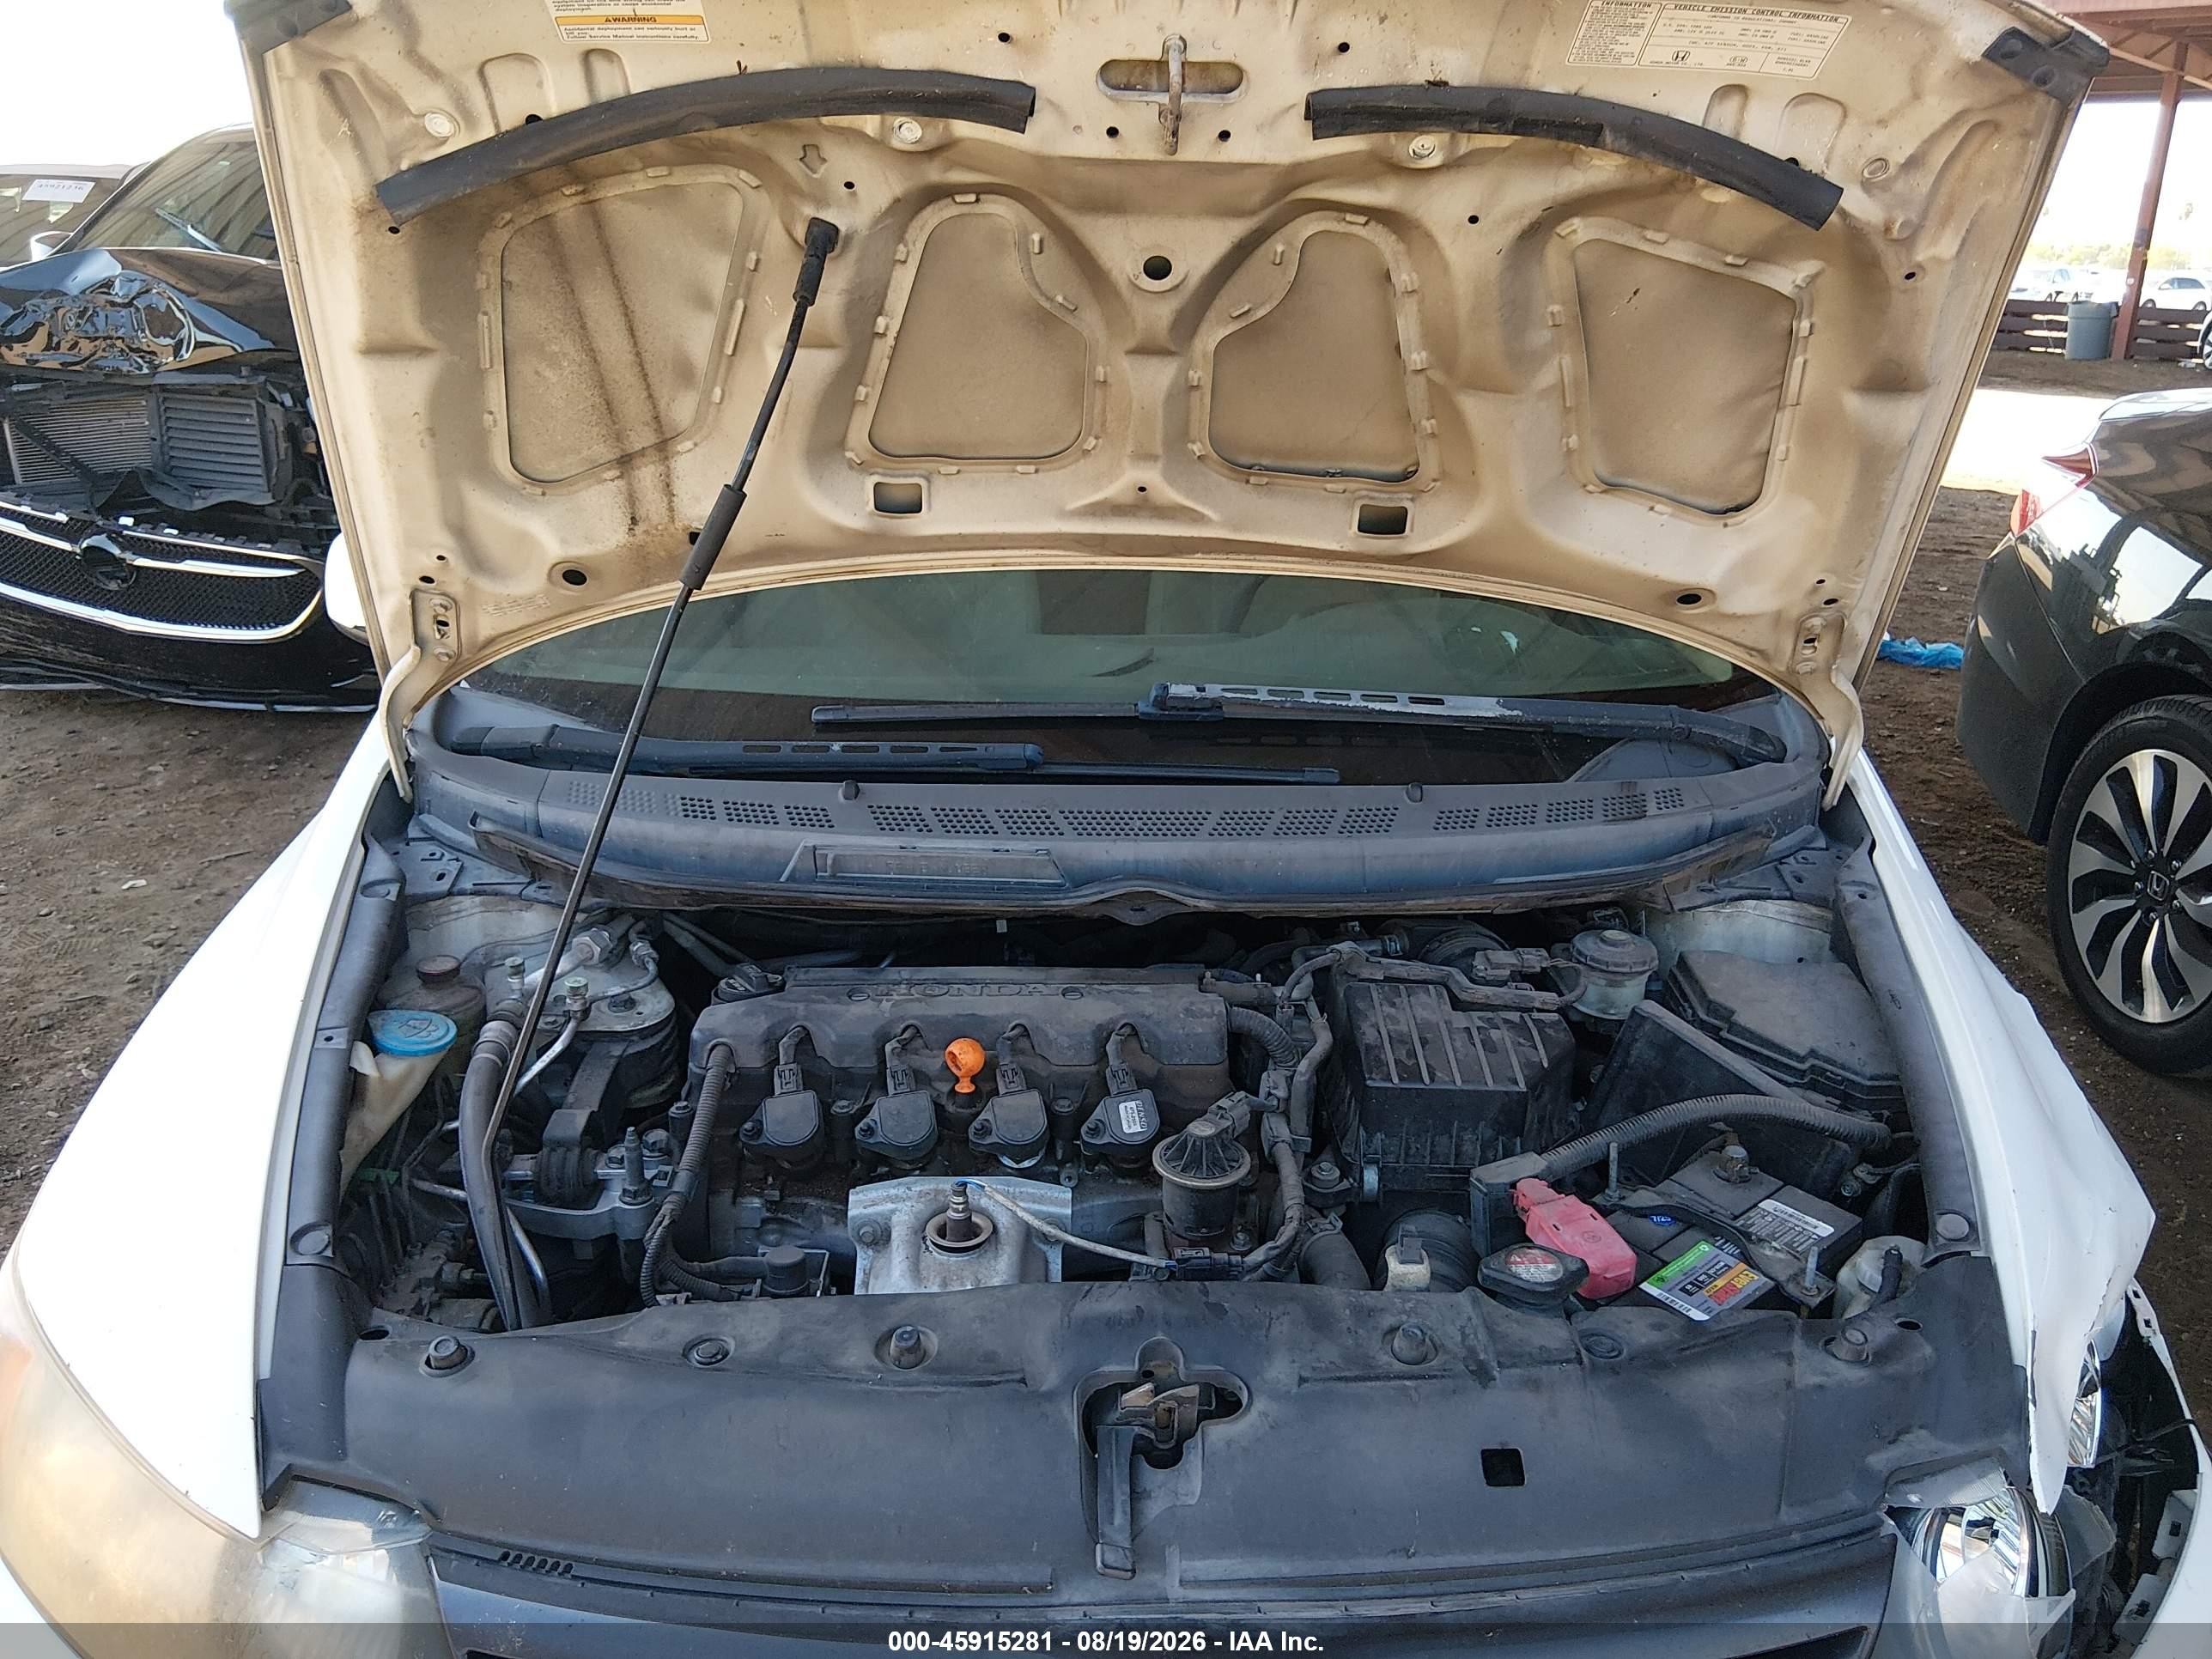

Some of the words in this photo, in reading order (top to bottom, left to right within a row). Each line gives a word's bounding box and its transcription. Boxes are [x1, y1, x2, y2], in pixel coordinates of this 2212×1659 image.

[1752, 9, 1784, 17] CONTROL
[1789, 11, 1839, 22] INFORMATION
[875, 983, 1060, 997] HONDA
[1137, 1100, 1148, 1128] DENSO
